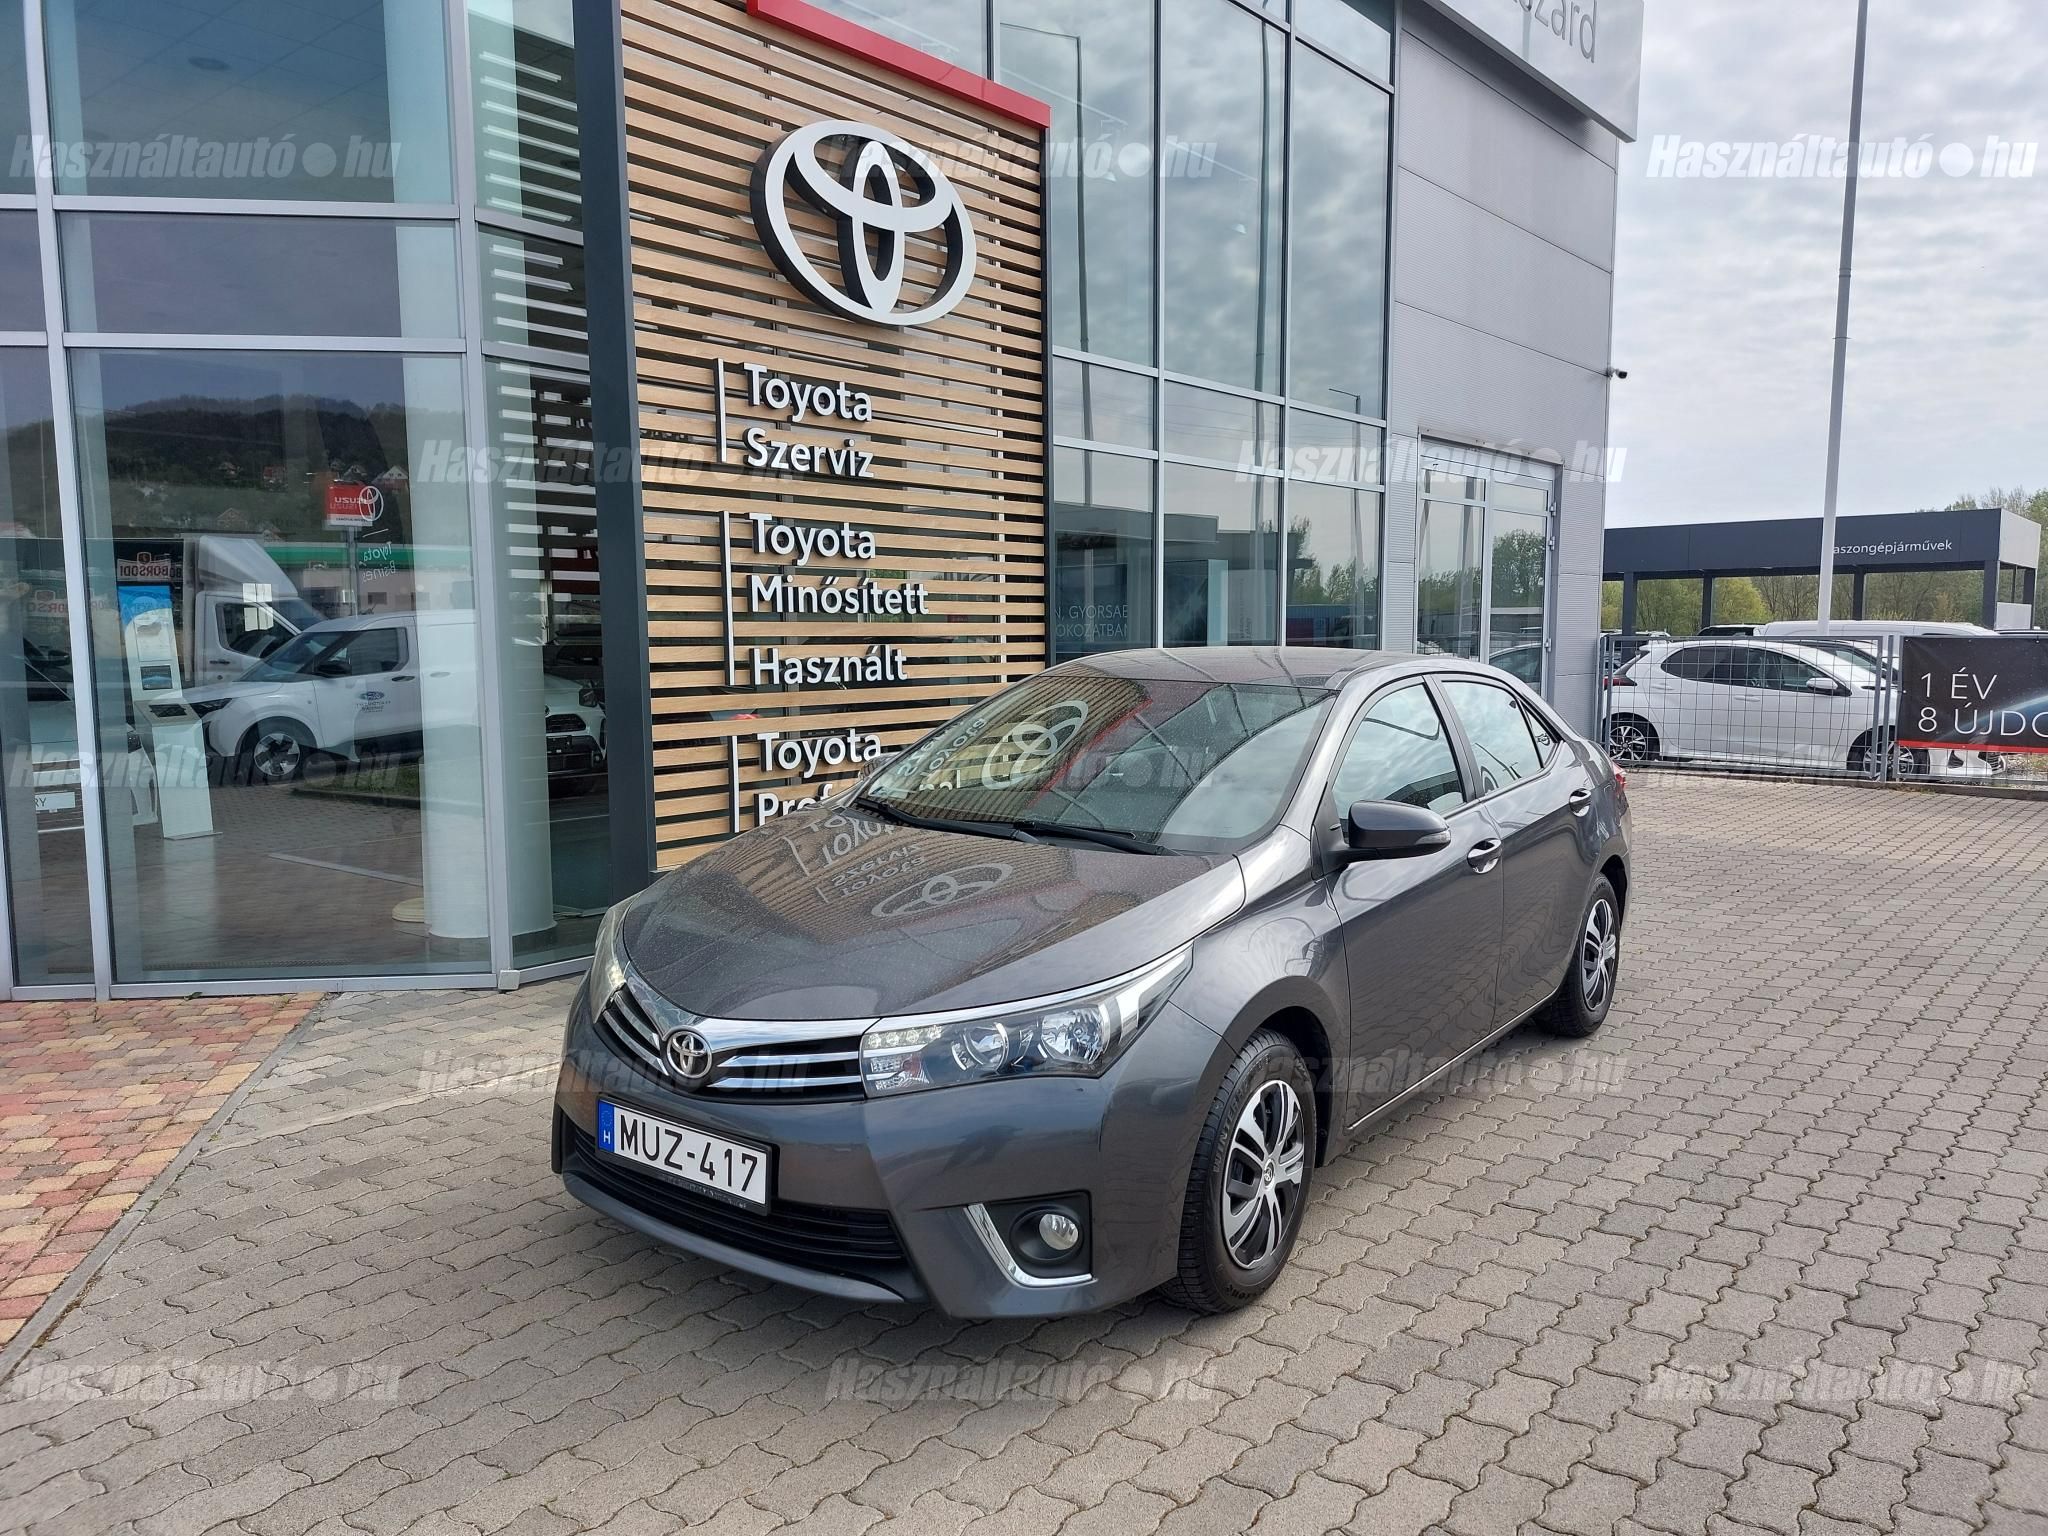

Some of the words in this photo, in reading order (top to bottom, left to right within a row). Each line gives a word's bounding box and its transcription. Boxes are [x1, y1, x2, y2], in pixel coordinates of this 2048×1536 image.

[743, 362, 872, 422] Toyota
[743, 427, 874, 477] Szerviz
[748, 513, 876, 566] Toyota
[751, 575, 930, 615] Minősített
[753, 645, 908, 685] Használt
[1921, 672, 1932, 698] 1
[1951, 666, 1998, 700] ÉV
[1918, 706, 1937, 733] 8
[757, 728, 881, 779] Toyota
[620, 1114, 758, 1193] MUZ-417
